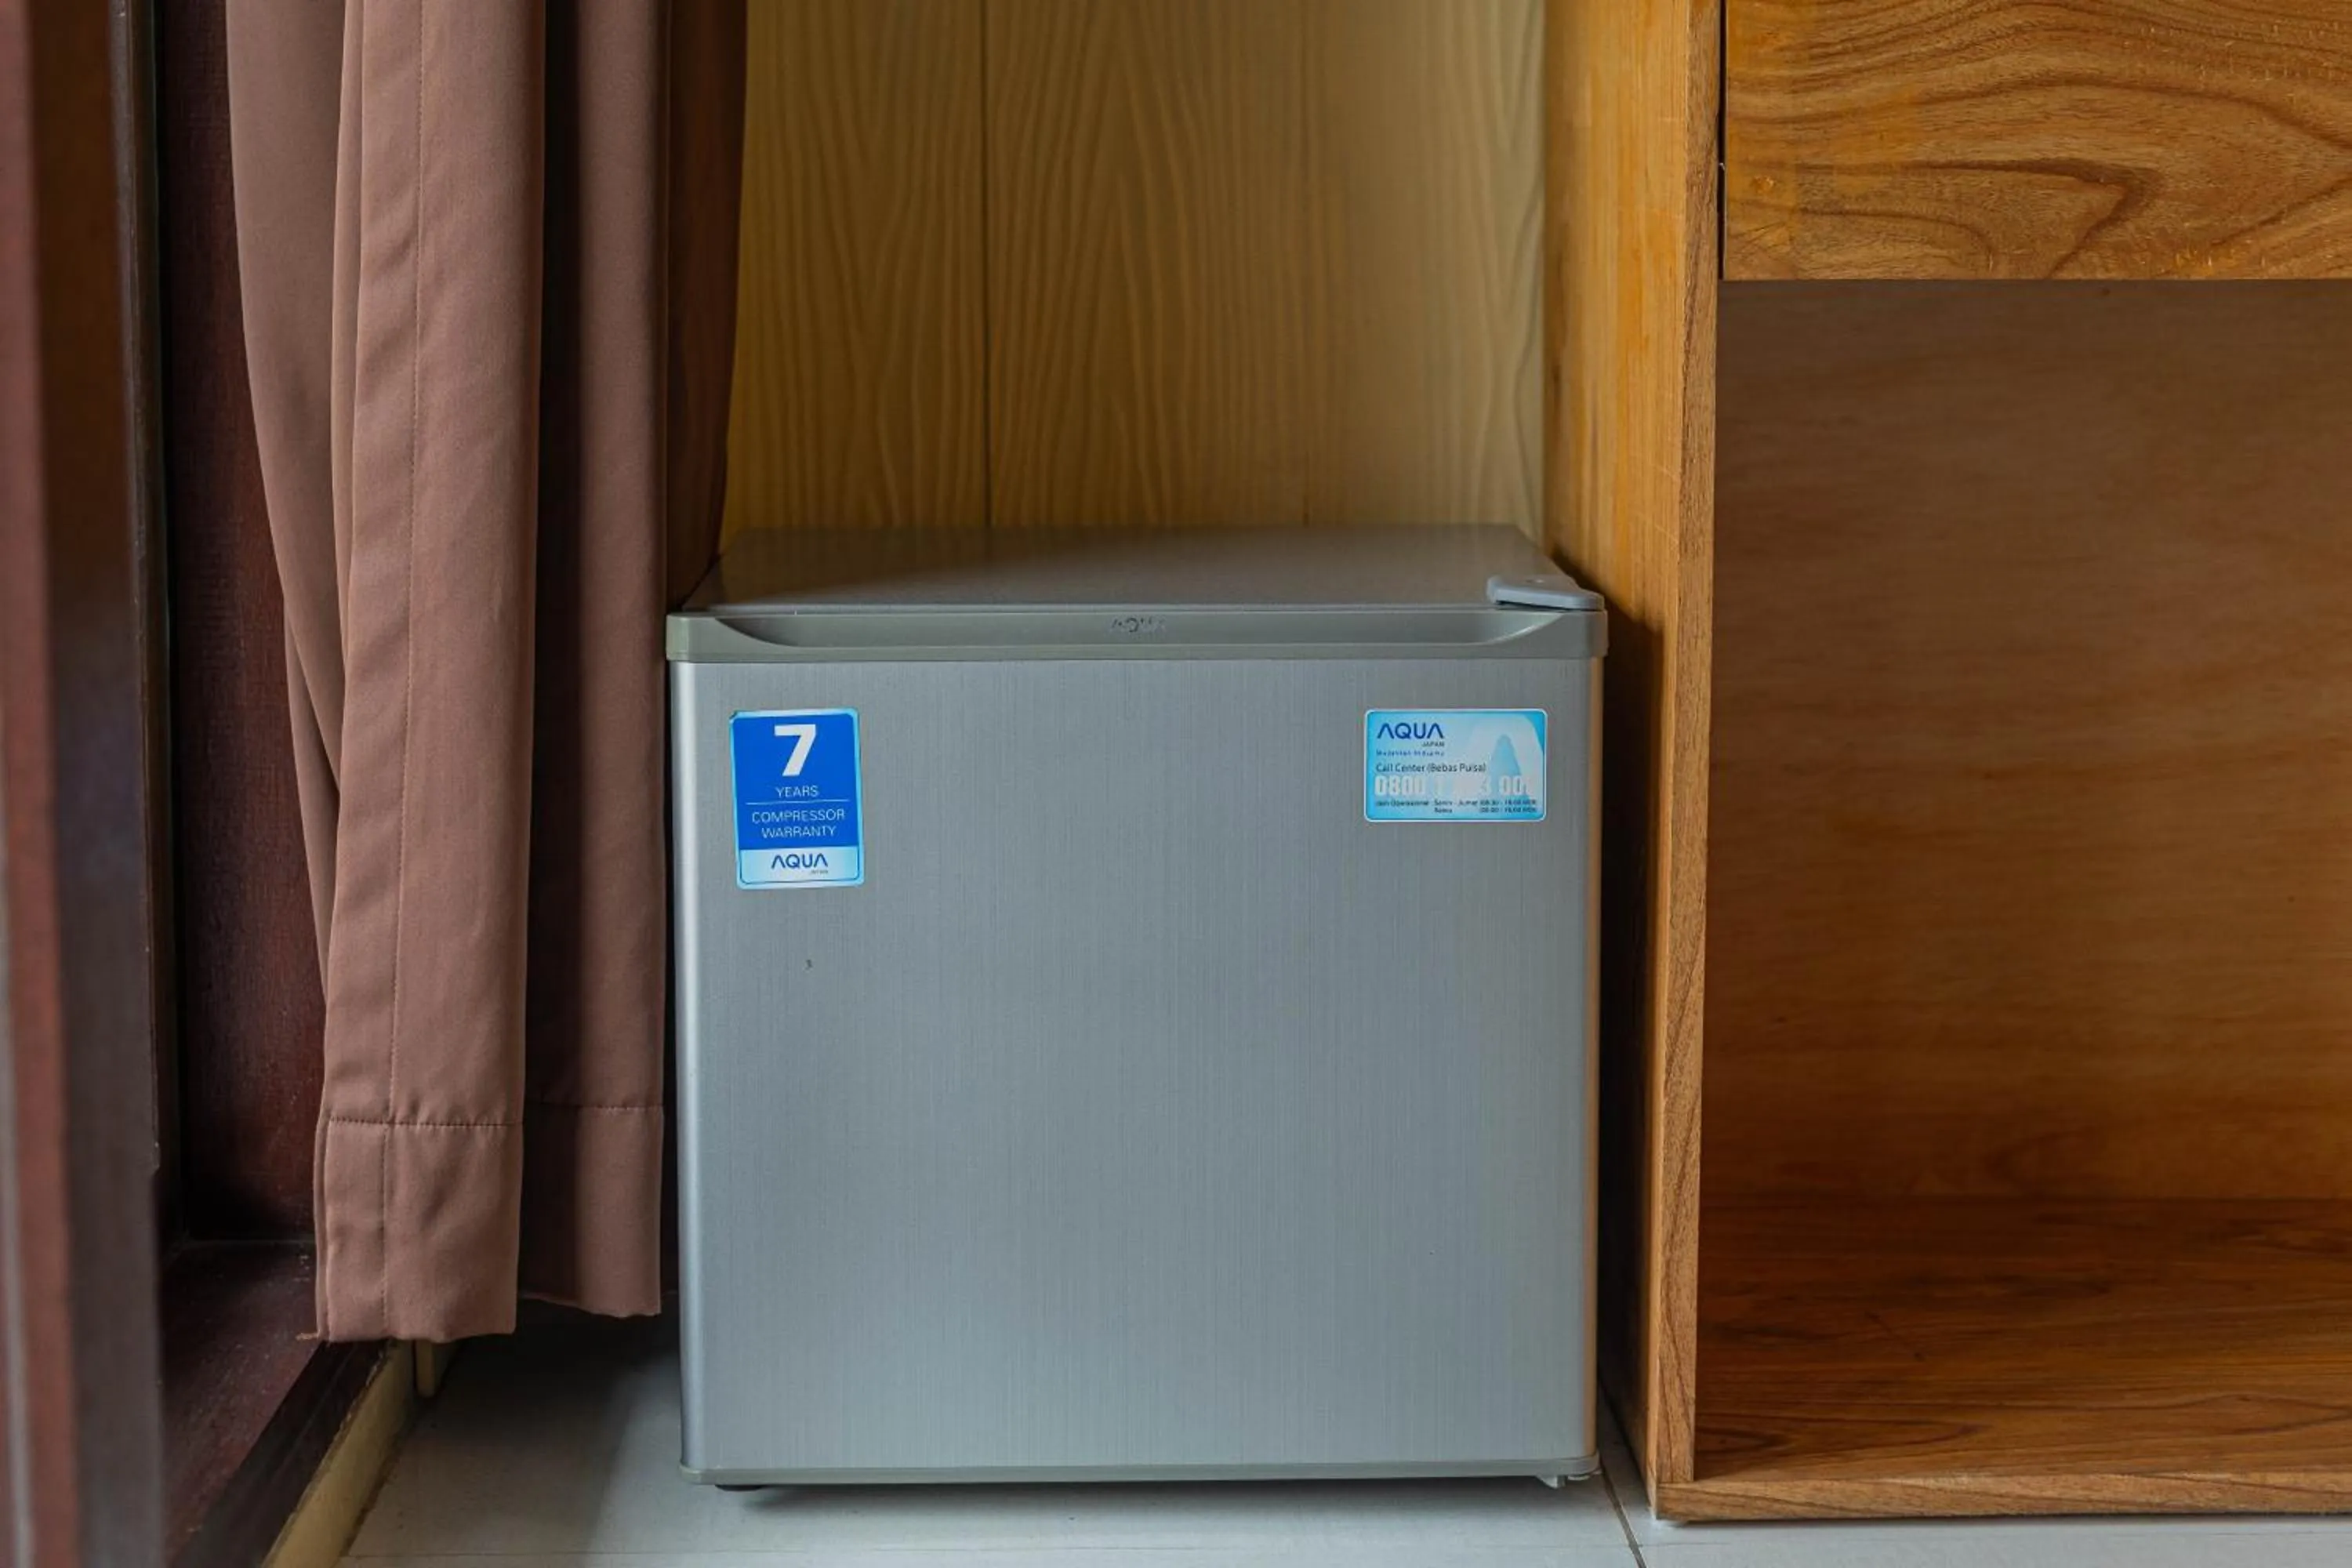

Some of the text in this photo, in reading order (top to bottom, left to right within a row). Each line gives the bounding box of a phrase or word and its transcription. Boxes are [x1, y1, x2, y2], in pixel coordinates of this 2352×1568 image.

[1377, 722, 1444, 739] AQUA
[774, 724, 817, 777] 7
[1376, 761, 1486, 774] Call Center (Bebas Pusa)
[775, 785, 819, 798] YEARS
[1374, 775, 1425, 797] 0800
[751, 808, 846, 824] COMPRESSOR
[761, 826, 837, 839] WARRANTY
[771, 853, 829, 870] AQUA
